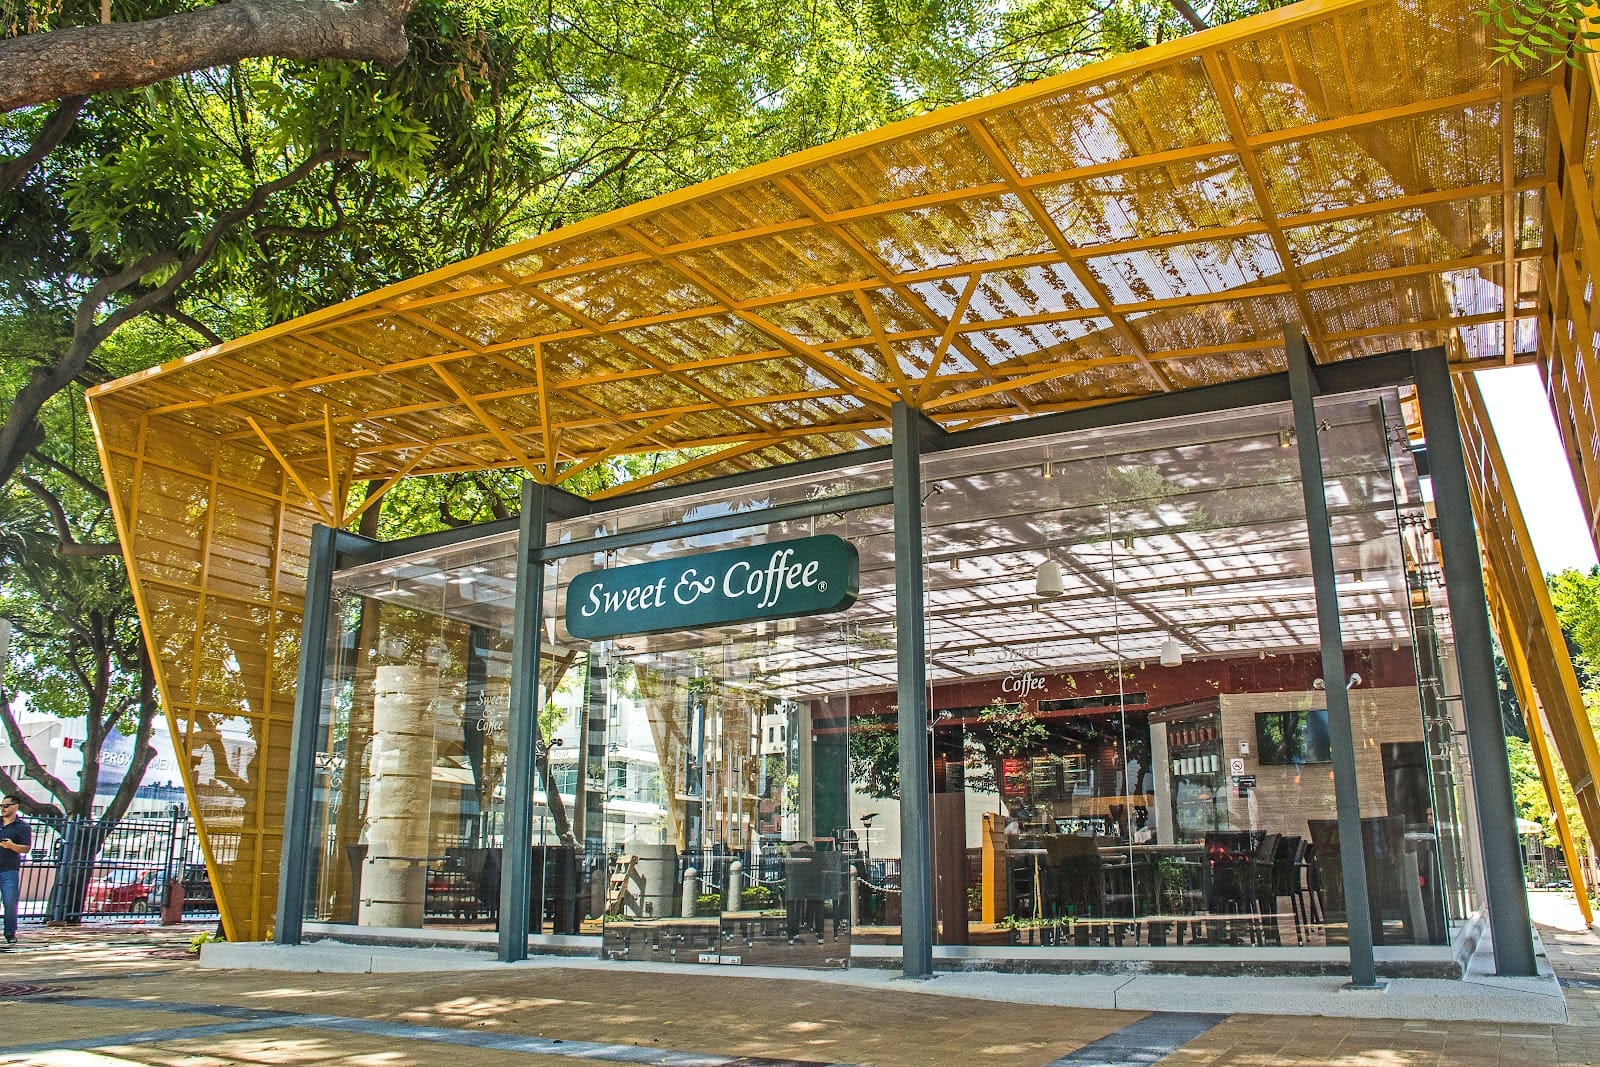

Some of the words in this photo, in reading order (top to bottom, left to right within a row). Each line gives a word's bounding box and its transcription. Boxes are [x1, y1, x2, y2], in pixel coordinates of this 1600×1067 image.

[581, 573, 667, 617] Sweet
[673, 568, 716, 605] &
[1001, 671, 1046, 697] Coffee
[476, 690, 505, 706] Sweet
[476, 718, 504, 736] Coffee
